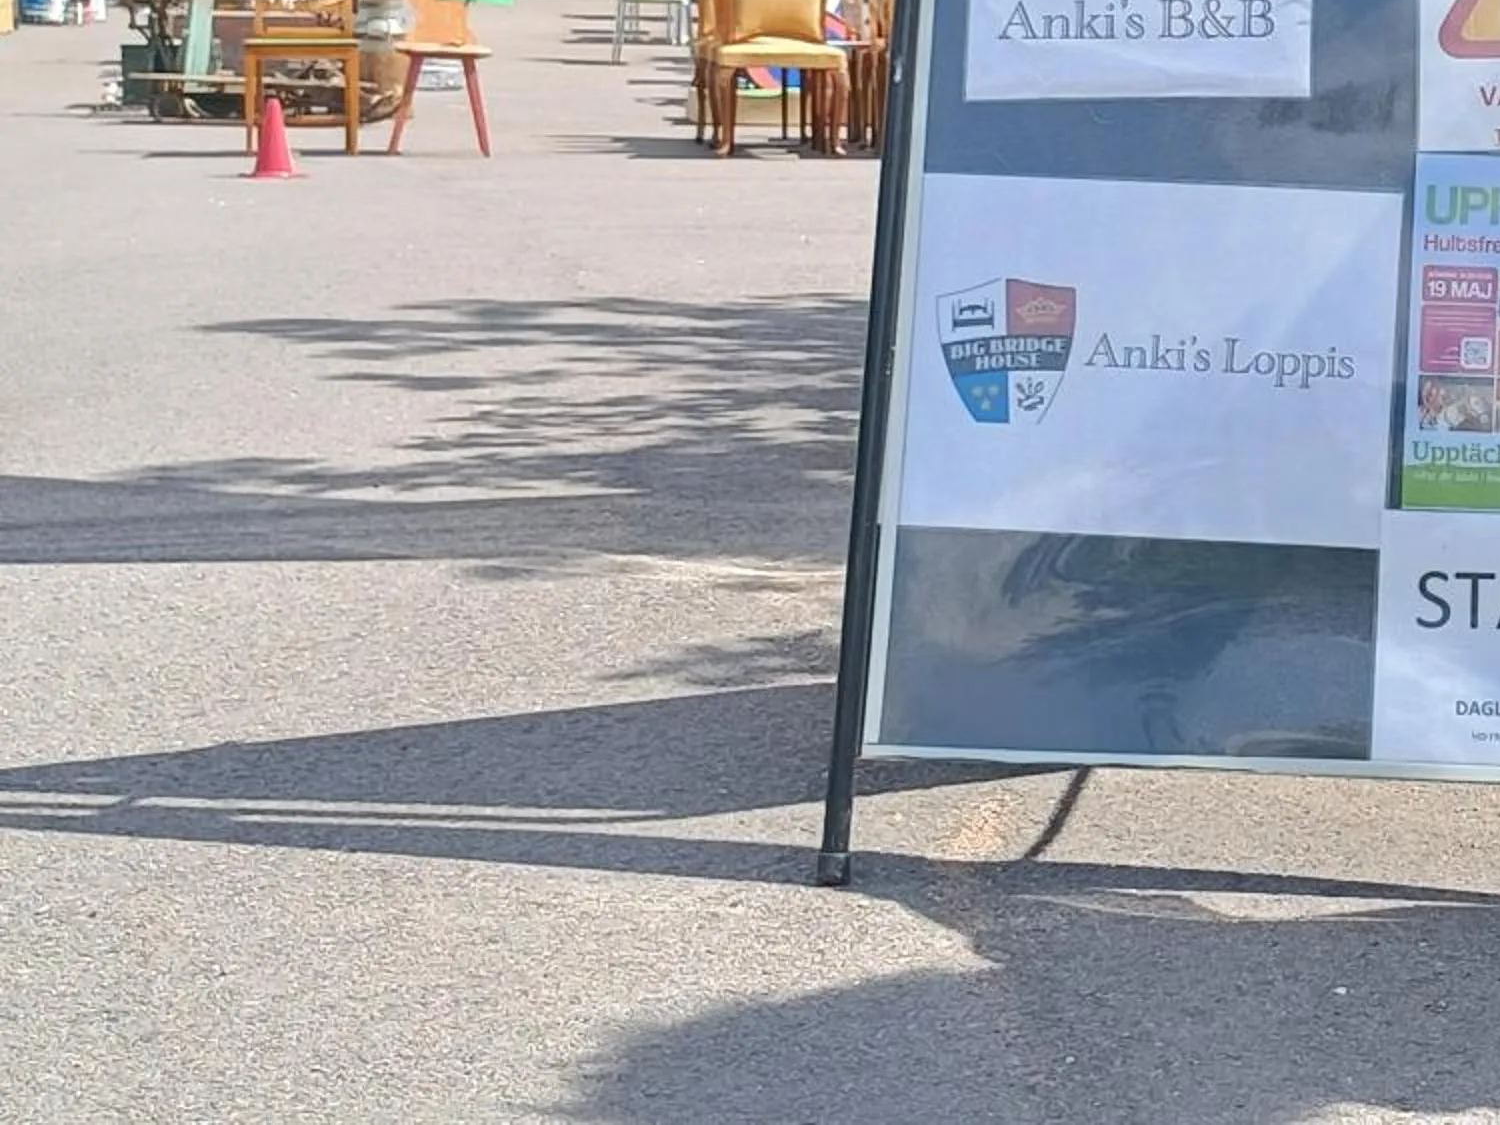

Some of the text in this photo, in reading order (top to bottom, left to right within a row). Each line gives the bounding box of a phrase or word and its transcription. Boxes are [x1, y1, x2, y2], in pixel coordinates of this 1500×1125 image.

[1428, 280, 1493, 299] 19 MAJ
[989, 336, 1068, 353] BRIDGE
[975, 352, 1041, 370] HOUSE
[1084, 332, 1357, 388] Anki's Loppis
